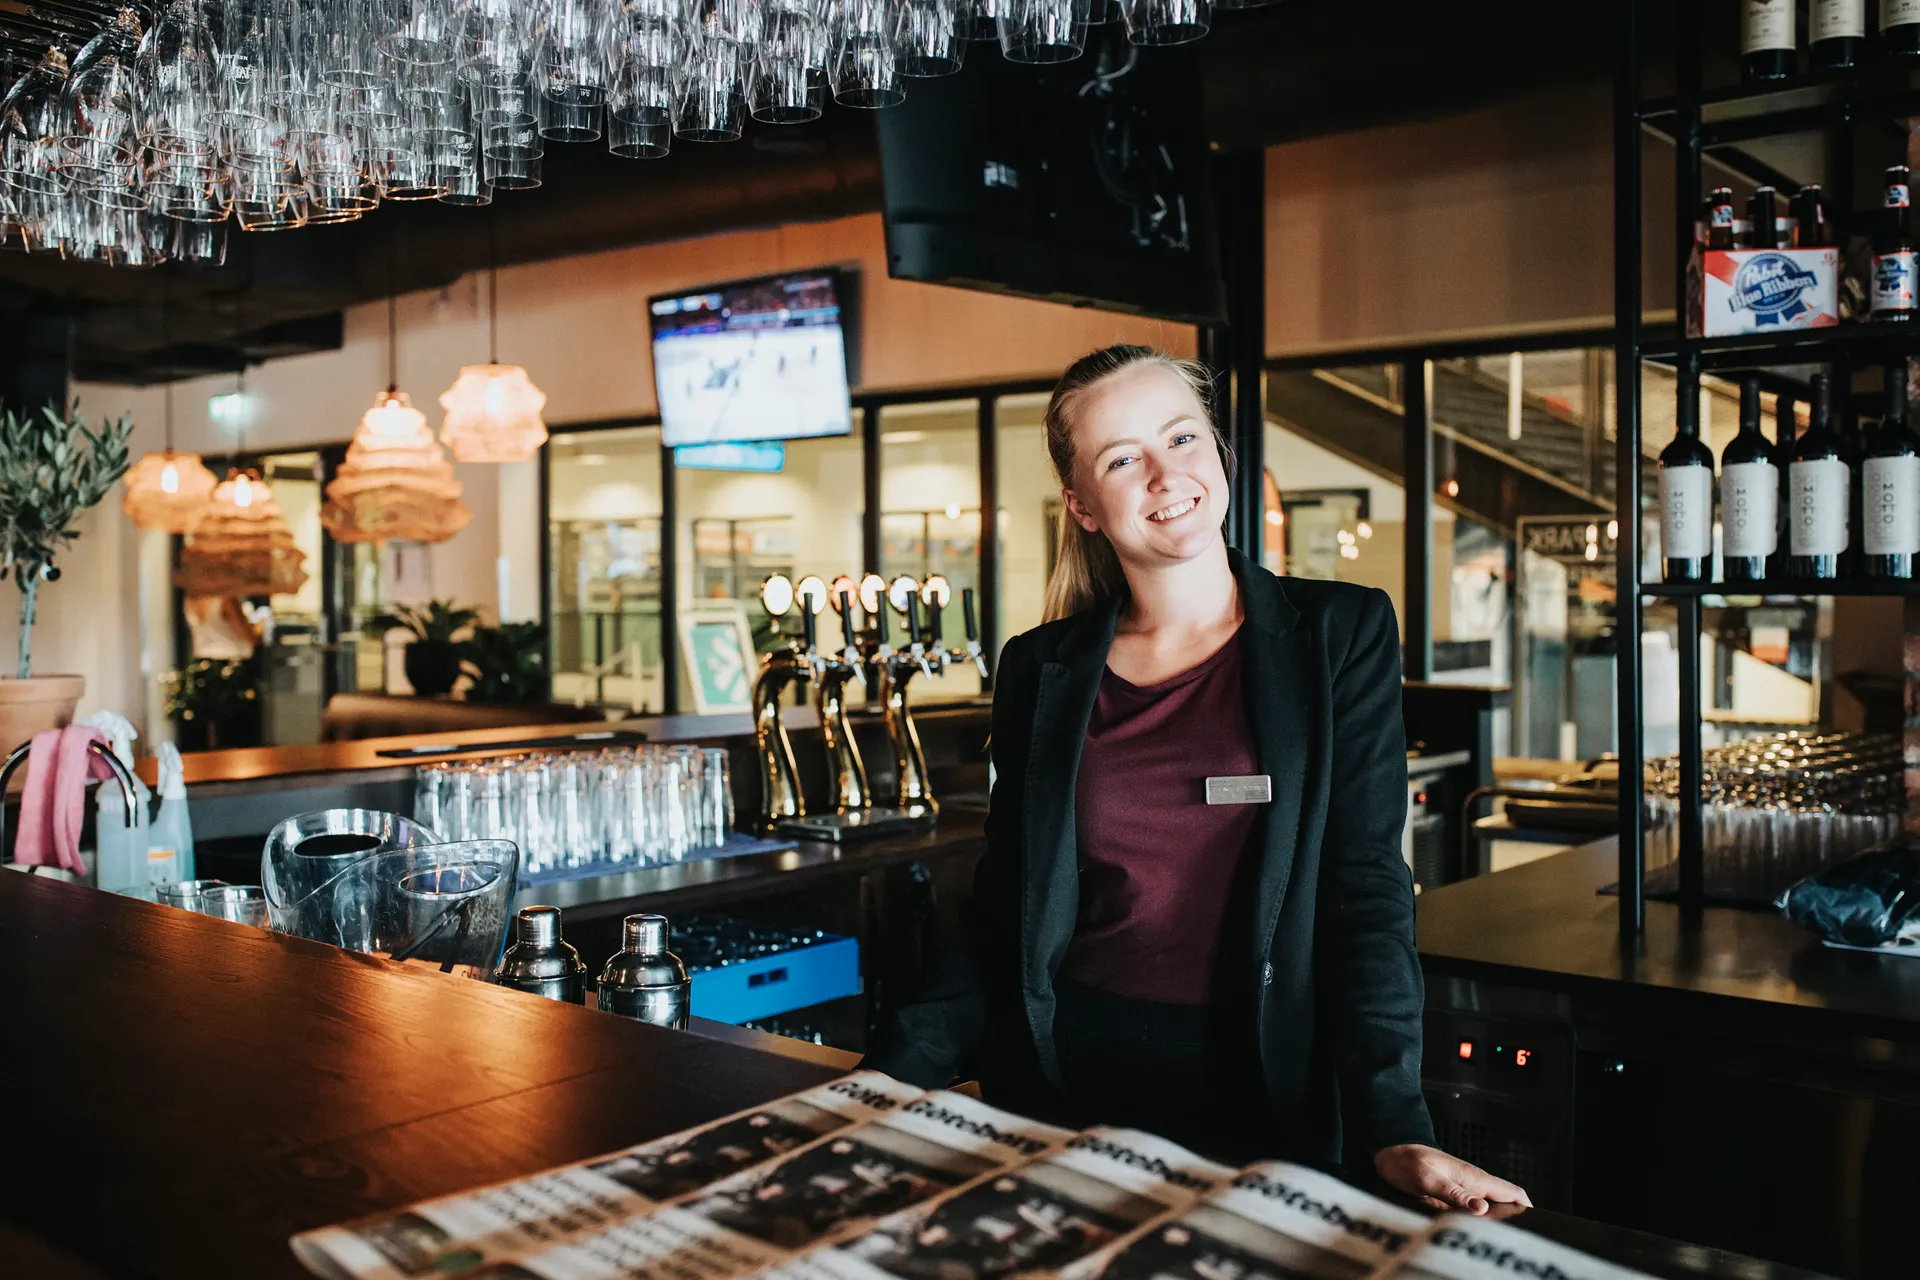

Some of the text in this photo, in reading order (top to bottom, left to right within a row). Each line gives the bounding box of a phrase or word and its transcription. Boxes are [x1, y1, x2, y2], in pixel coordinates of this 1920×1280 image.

[1742, 261, 1787, 288] Pabst
[1731, 288, 1763, 313] Blue
[1761, 275, 1815, 298] Ribbon
